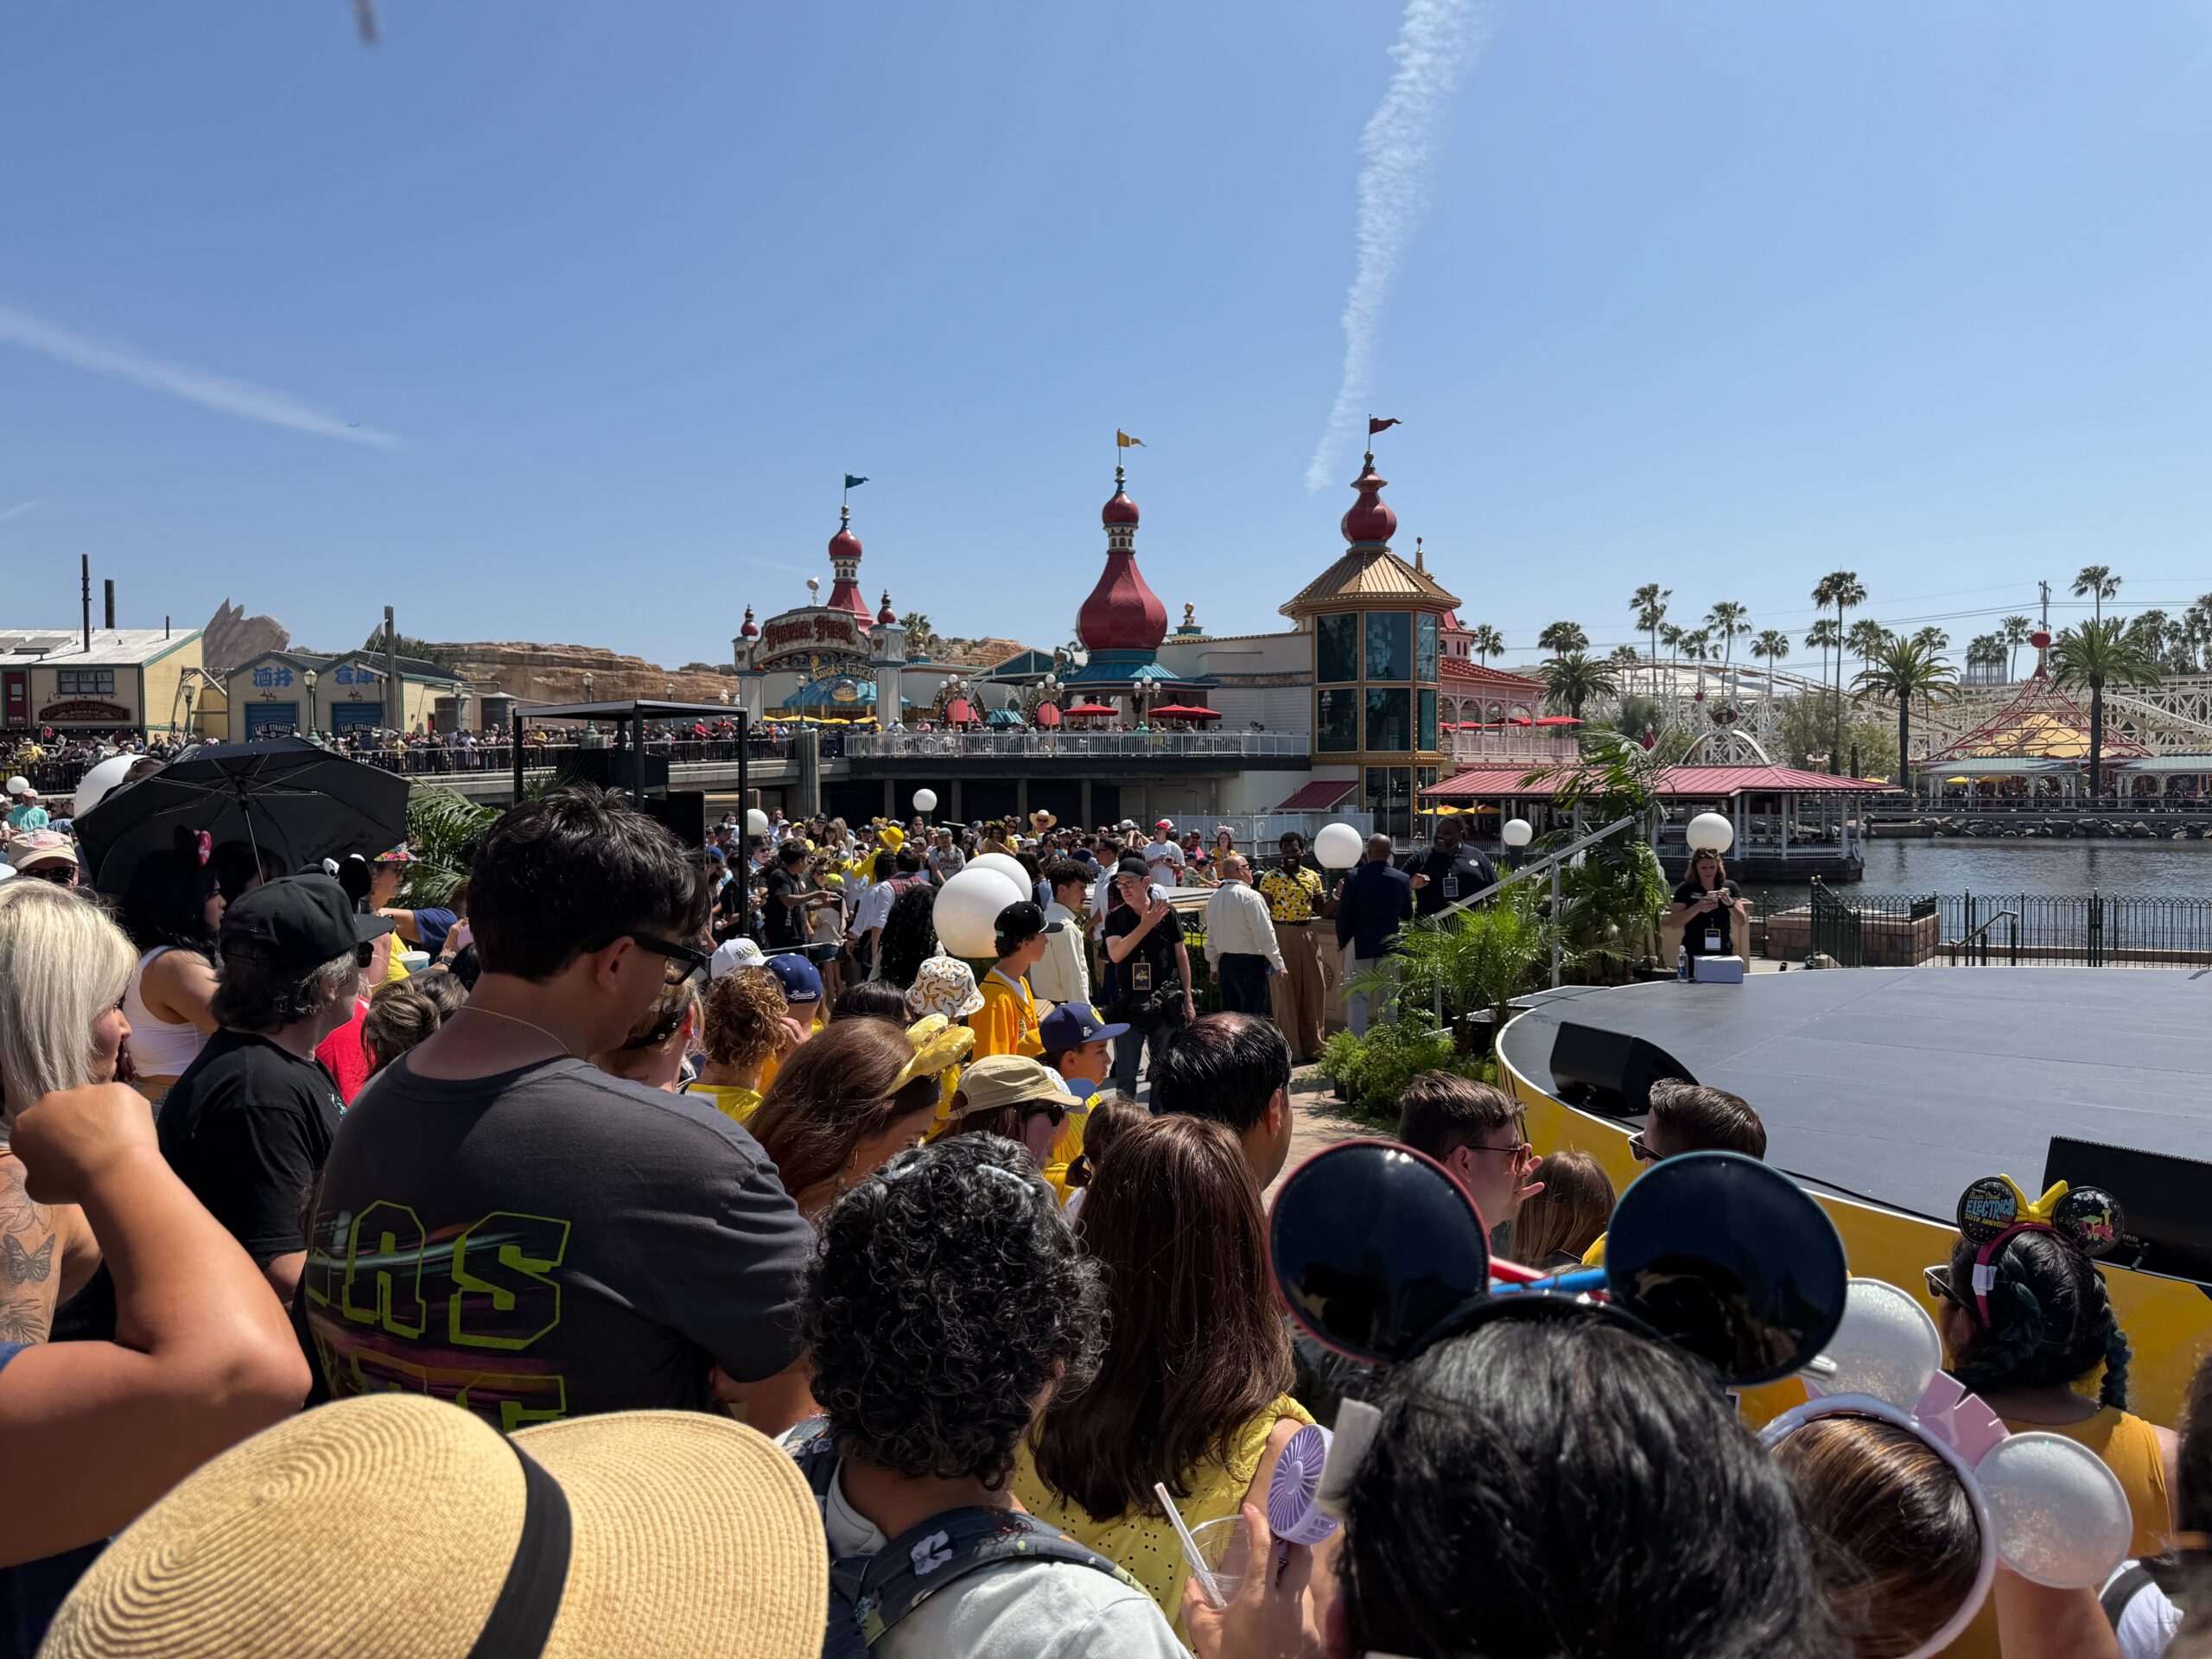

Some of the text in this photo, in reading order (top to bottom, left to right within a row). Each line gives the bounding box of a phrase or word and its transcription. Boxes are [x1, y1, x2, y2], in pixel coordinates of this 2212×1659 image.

[814, 615, 856, 645] PIER
[43, 702, 124, 719] COCINA CUCAMONGA
[255, 723, 292, 734] KARL STRAUSS
[340, 723, 354, 732] KARL
[1968, 1192, 2001, 1200] Main Street
[1964, 1213, 1981, 1222] 50TH
